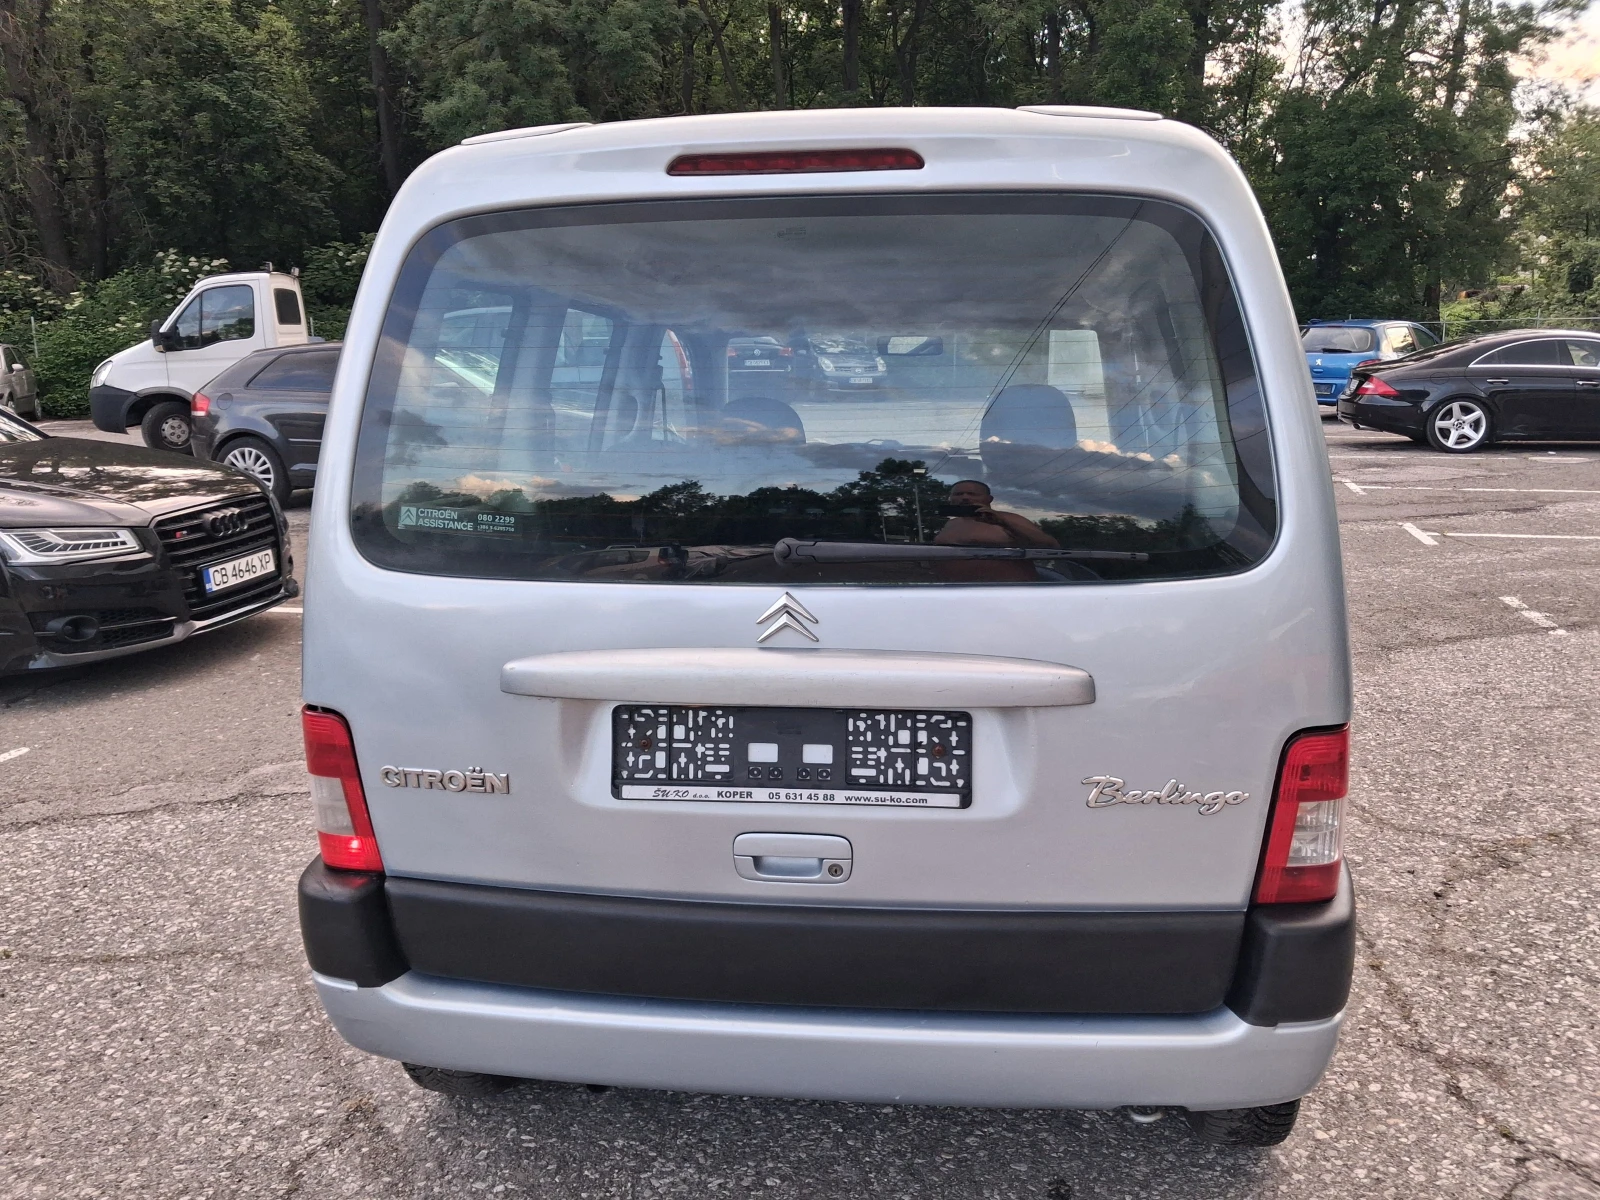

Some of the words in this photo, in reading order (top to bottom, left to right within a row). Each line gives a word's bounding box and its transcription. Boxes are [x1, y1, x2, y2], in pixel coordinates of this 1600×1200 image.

[417, 508, 458, 520] CITROËN
[477, 513, 493, 522] 080
[495, 515, 515, 524] 2299
[417, 518, 474, 531] ASSISTANCE
[212, 567, 229, 586] CB
[231, 559, 258, 581] 4646
[257, 553, 271, 573] XP
[380, 765, 510, 794] CITROËN
[716, 790, 753, 799] KOPER
[768, 792, 781, 800] 05
[785, 792, 803, 801] 631
[807, 792, 819, 801] 45
[822, 793, 835, 802] 88
[844, 794, 928, 804] www.su-ko.com
[1081, 775, 1250, 816] Berlingo
